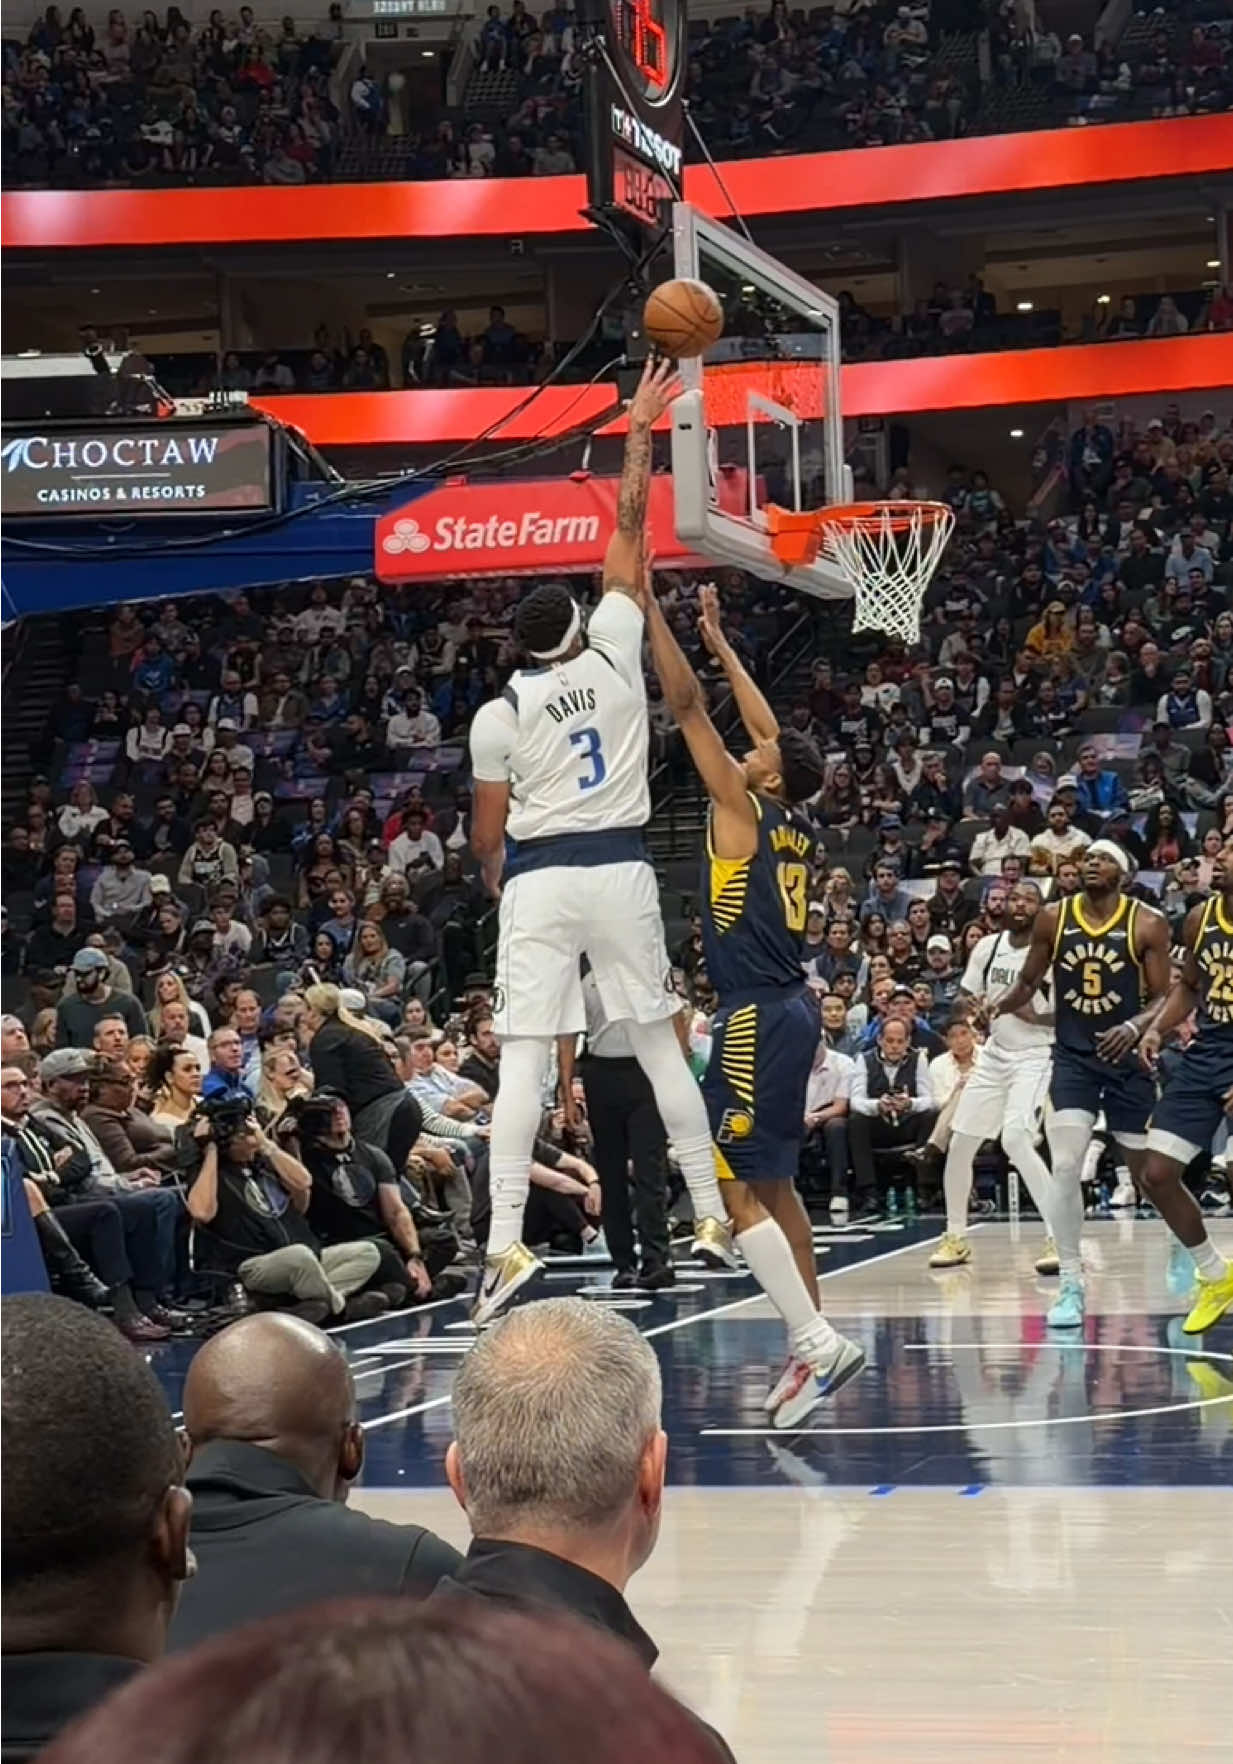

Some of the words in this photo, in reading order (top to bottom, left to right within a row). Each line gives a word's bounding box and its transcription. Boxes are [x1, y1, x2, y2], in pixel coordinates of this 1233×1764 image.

[23, 437, 218, 469] CHOCTAW
[37, 486, 111, 502] CASINOS
[116, 486, 127, 500] &
[132, 485, 205, 499] RESORTS
[545, 687, 597, 723] DAVIS
[569, 727, 607, 790] 3
[776, 861, 808, 931] 13
[1083, 962, 1102, 996] 5
